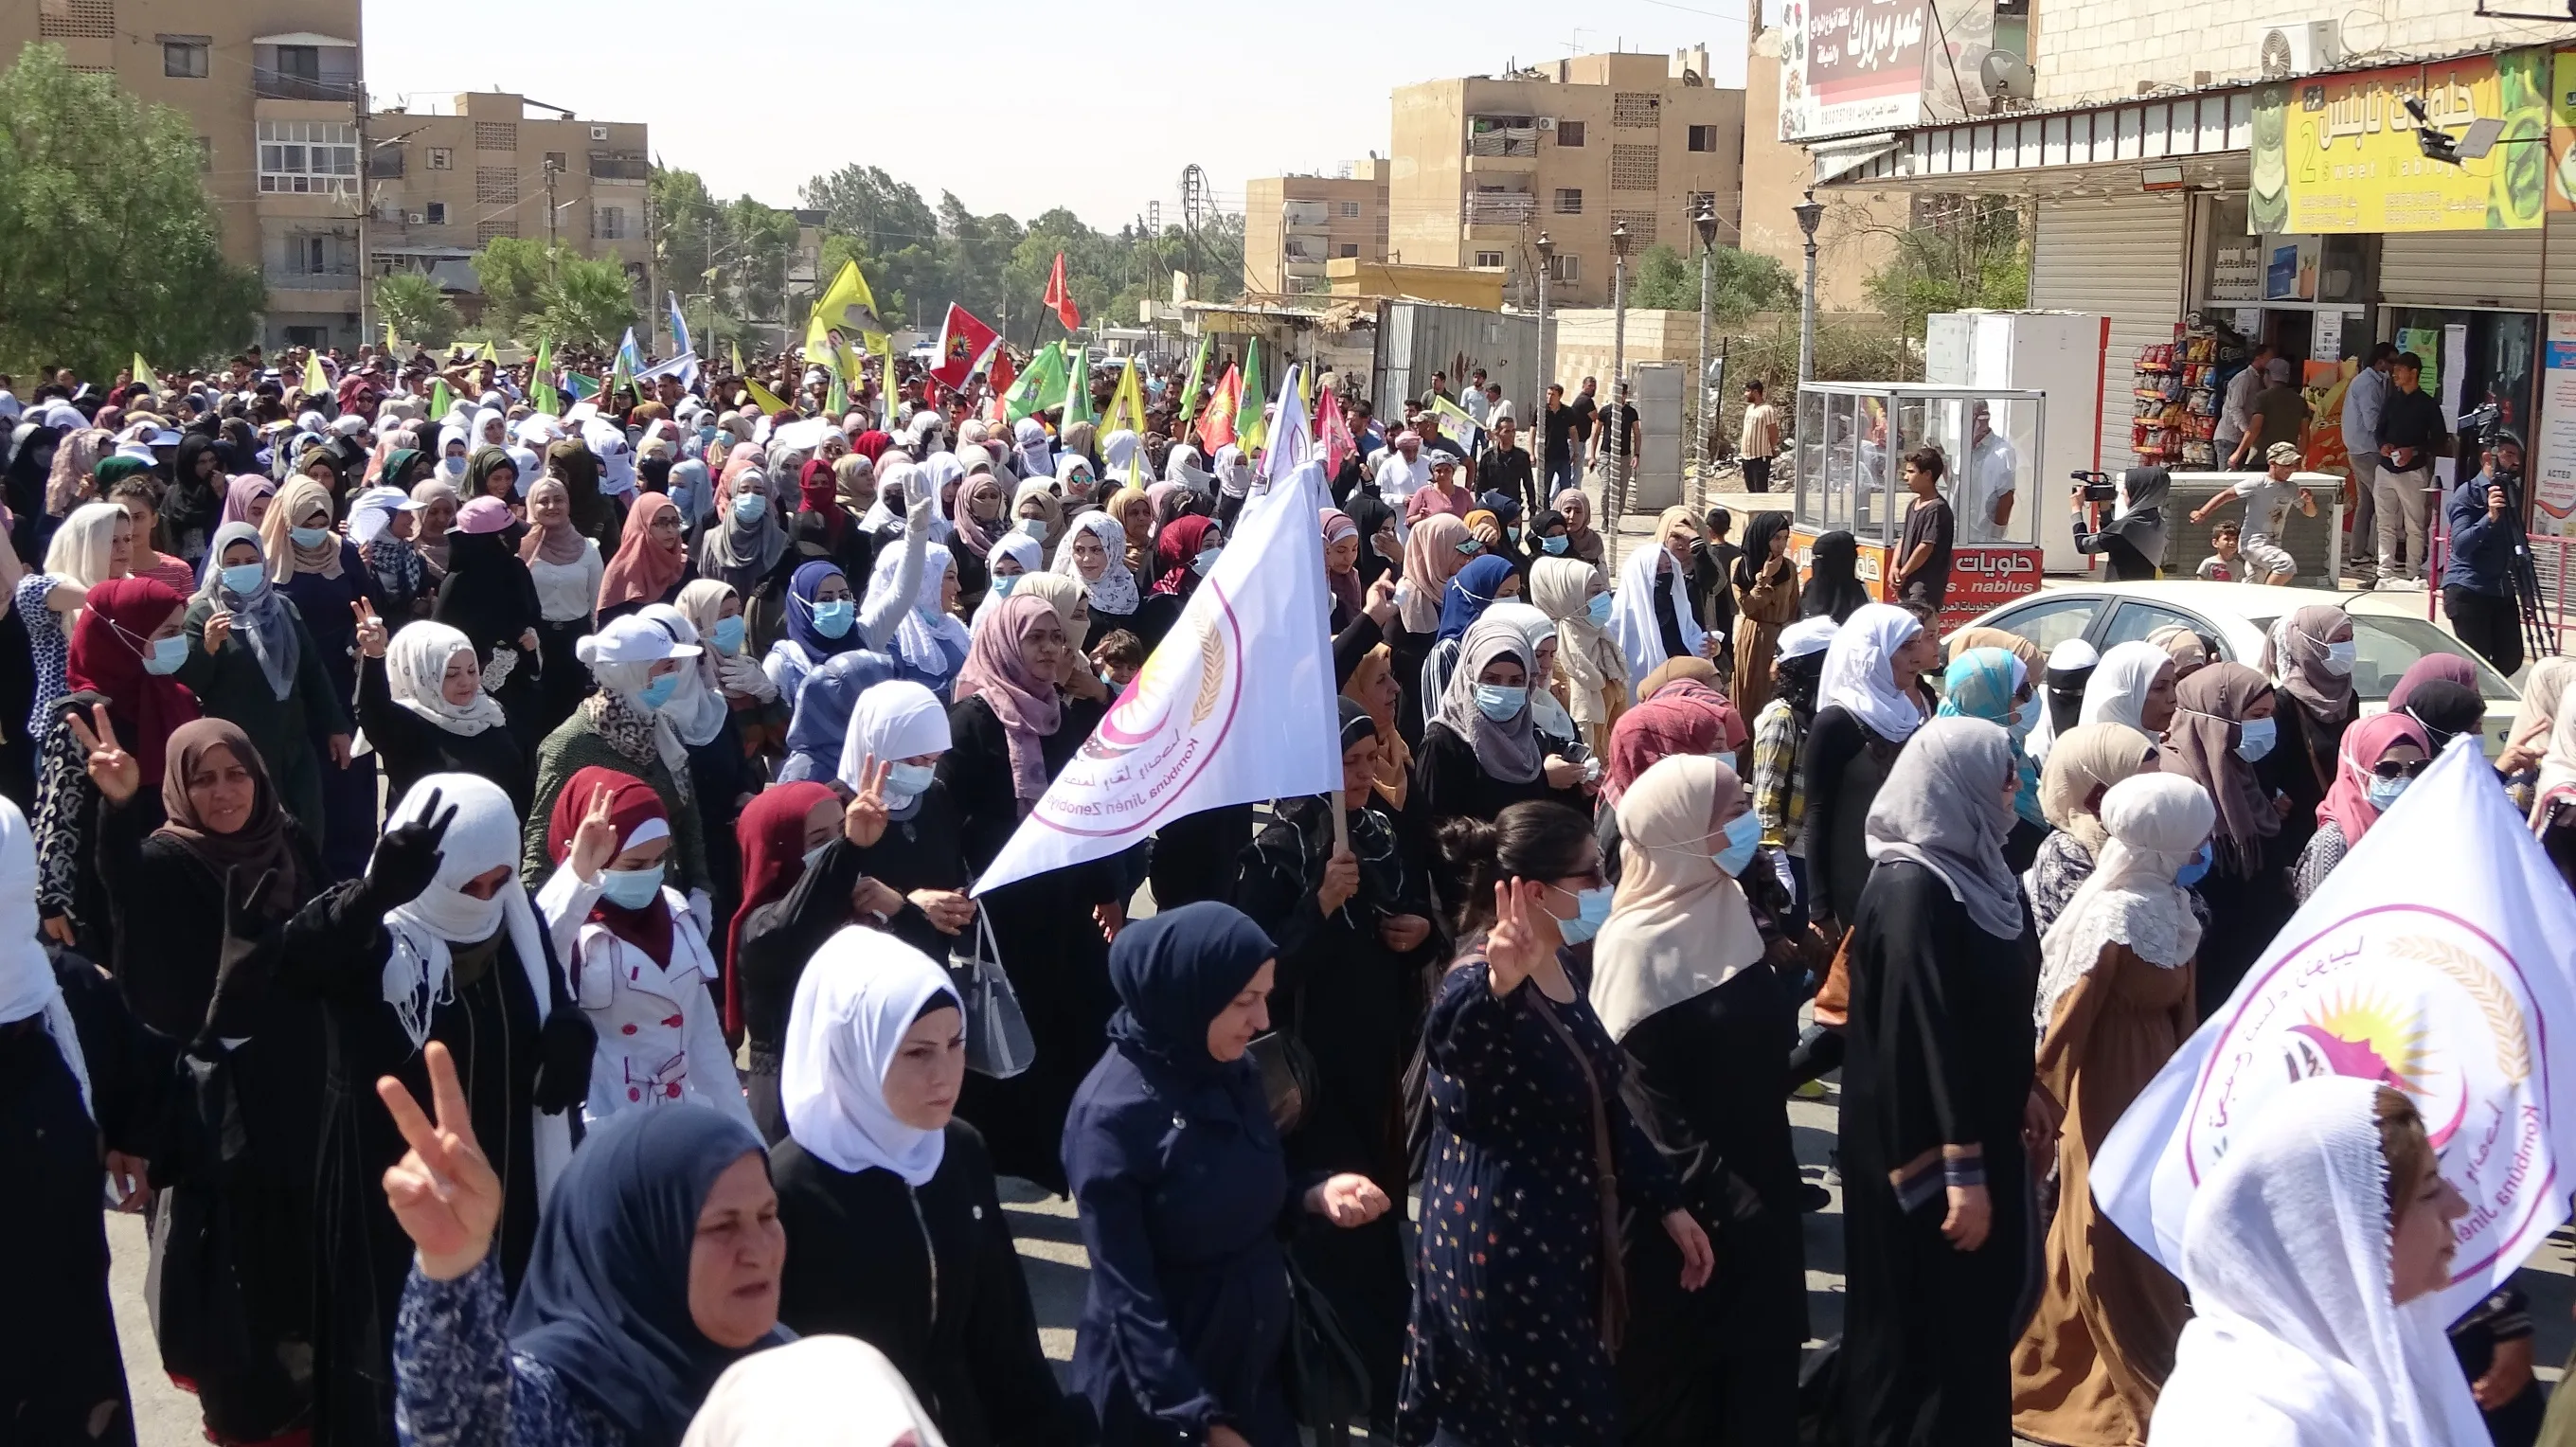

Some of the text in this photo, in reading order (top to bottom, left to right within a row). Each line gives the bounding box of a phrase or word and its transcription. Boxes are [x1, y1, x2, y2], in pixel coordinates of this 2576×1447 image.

[1847, 5, 1923, 72] عمو مبروك
[2318, 72, 2476, 150] حلوات نابلس
[2299, 120, 2316, 183] 2
[2321, 157, 2376, 181] Sweet
[1956, 551, 2034, 579] حلويات
[1971, 580, 2034, 594] nablus
